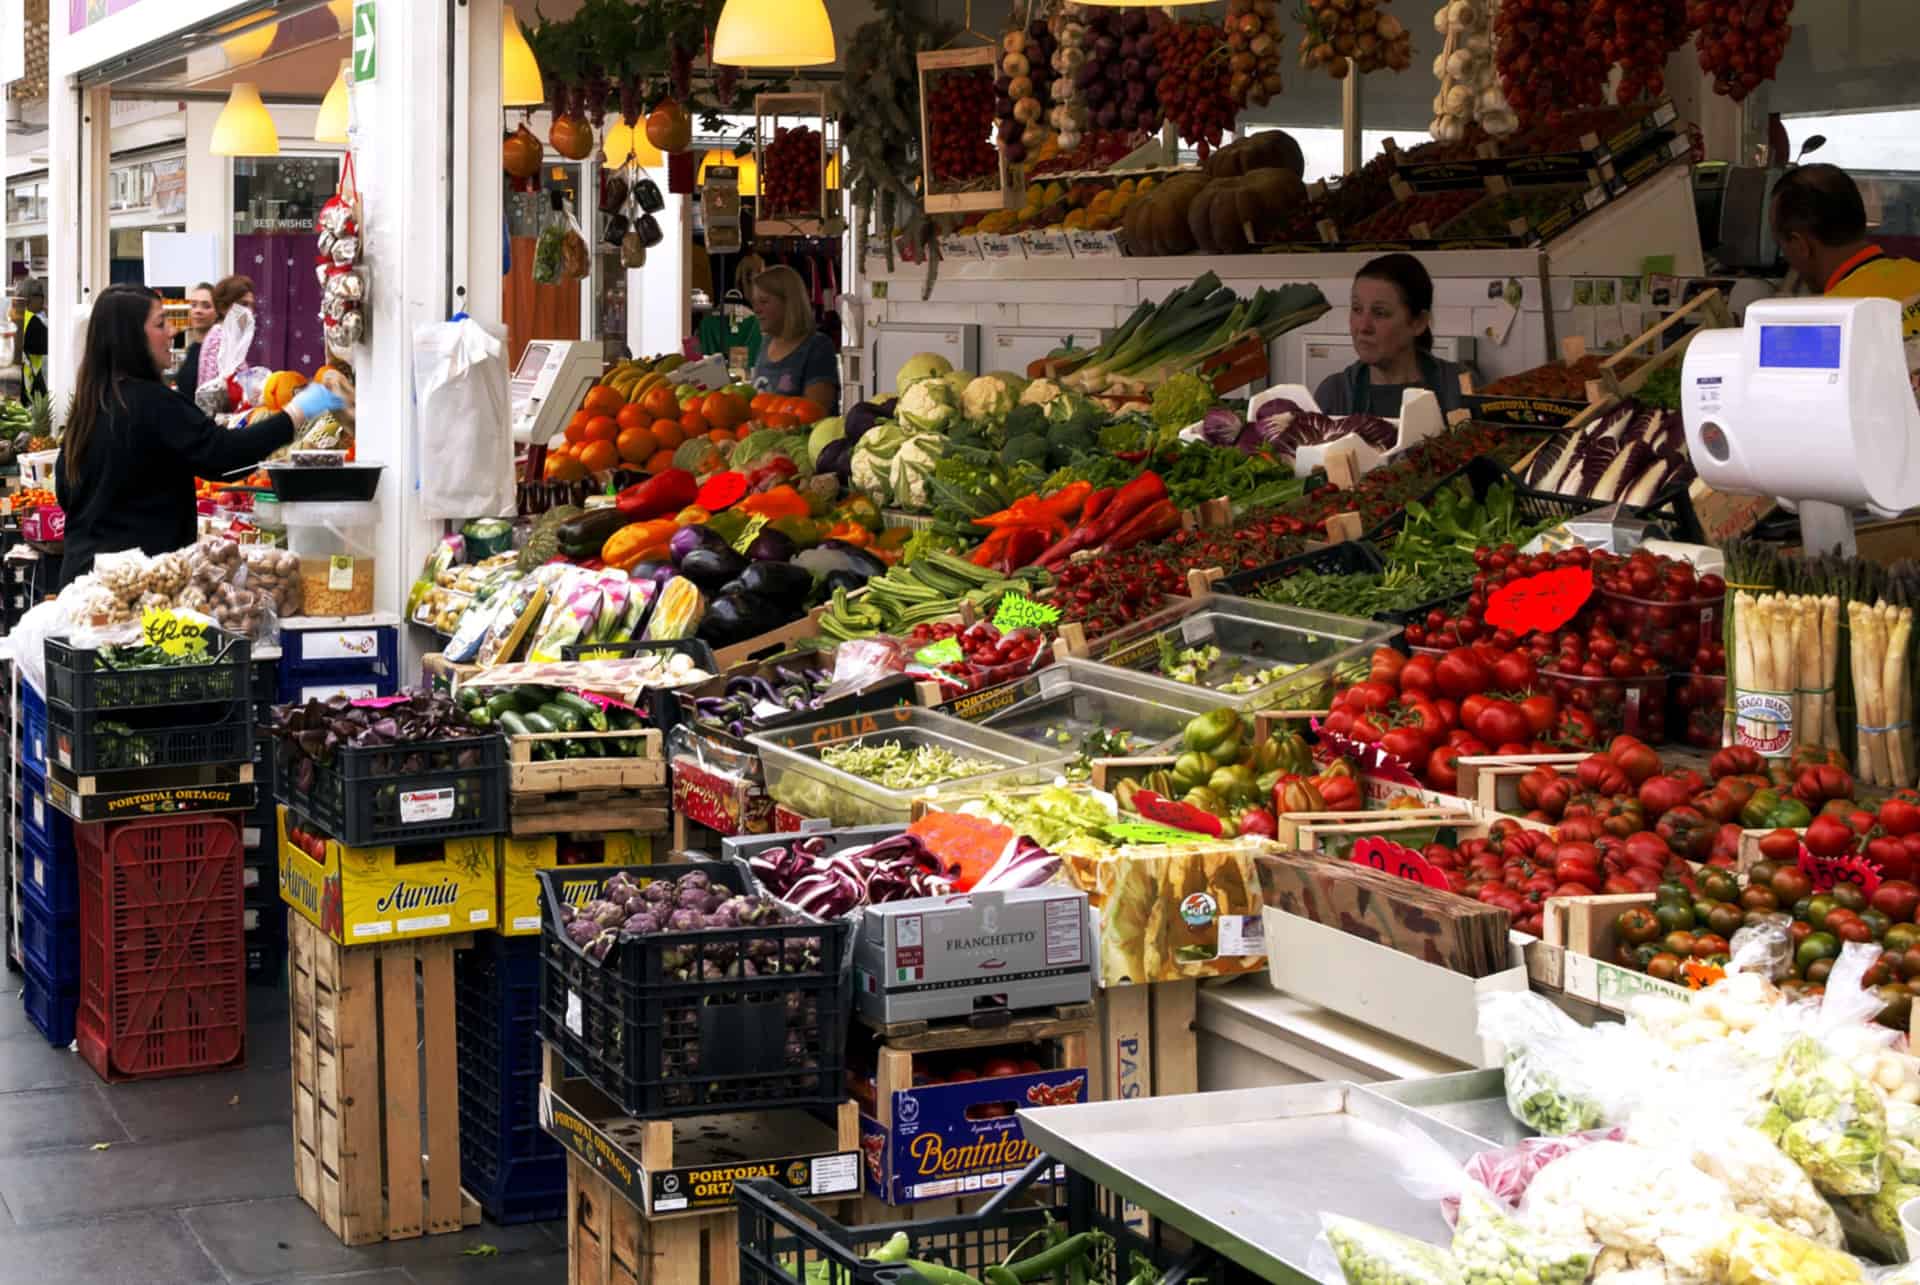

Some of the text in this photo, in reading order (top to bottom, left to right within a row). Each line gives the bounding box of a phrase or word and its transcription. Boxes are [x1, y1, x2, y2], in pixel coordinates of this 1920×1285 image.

[254, 218, 313, 229] BEST WISHES
[108, 789, 231, 812] PORTOPAL ORTAGGI
[376, 877, 459, 913] Aurnia
[946, 931, 1036, 951] FRANCHETTO
[688, 1163, 780, 1186] PORTOPAL
